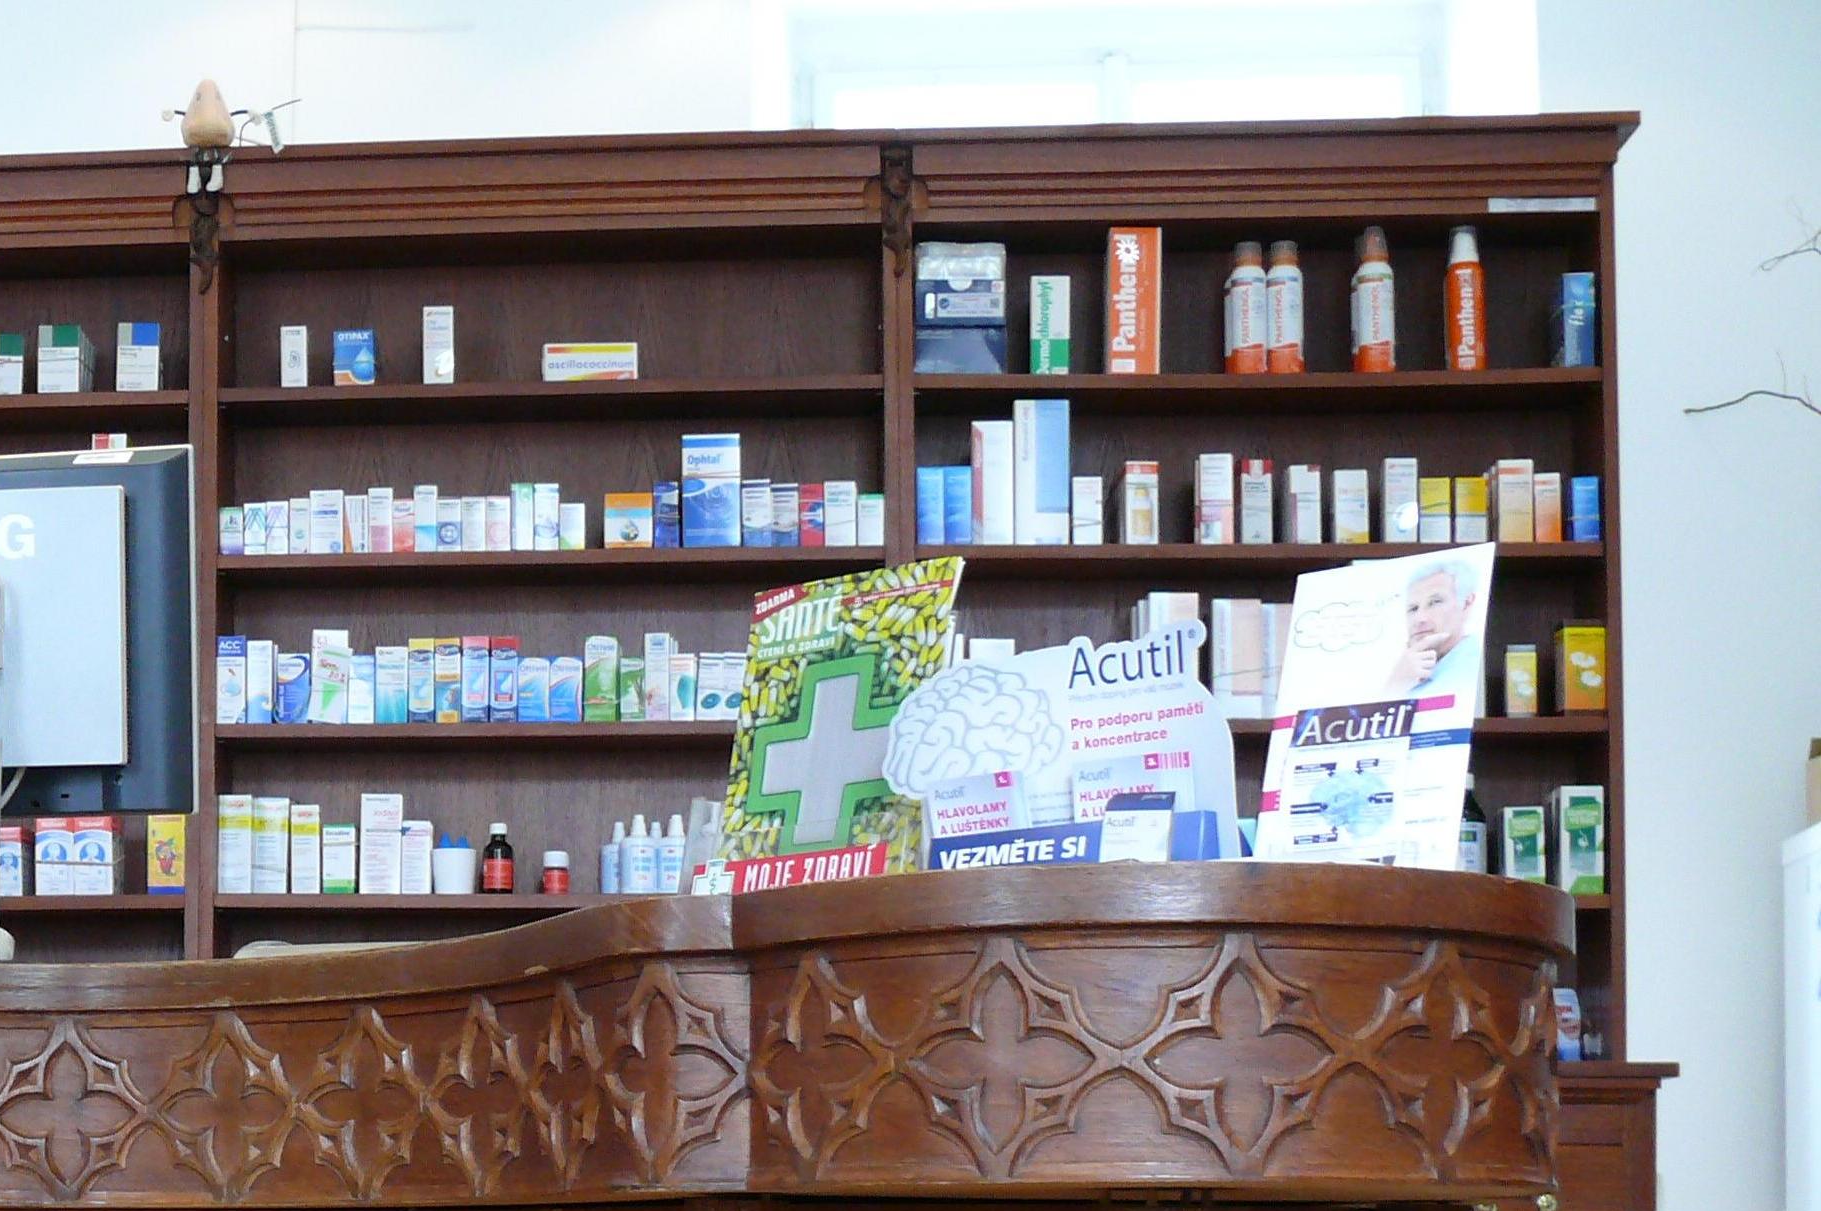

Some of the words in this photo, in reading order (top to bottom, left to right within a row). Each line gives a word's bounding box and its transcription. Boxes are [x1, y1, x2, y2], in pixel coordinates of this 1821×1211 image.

[338, 332, 369, 341] OTIPAX
[755, 588, 795, 615] ZDARMA
[760, 589, 844, 645] SANTÉ
[219, 641, 241, 649] ACC
[1069, 630, 1184, 689] Acutil
[1071, 718, 1092, 730] Pro
[1098, 710, 1152, 728] podporu
[1296, 705, 1408, 746] Acutil
[1072, 741, 1079, 750] a
[1084, 729, 1168, 748] koncentrace
[937, 801, 1007, 819] HLAVOLAMY
[940, 825, 948, 835] A
[940, 837, 1055, 870] VEZMĚTE
[1061, 836, 1087, 859] SI
[743, 860, 795, 893] MOJE
[803, 844, 877, 884] ZDRAVÍ
